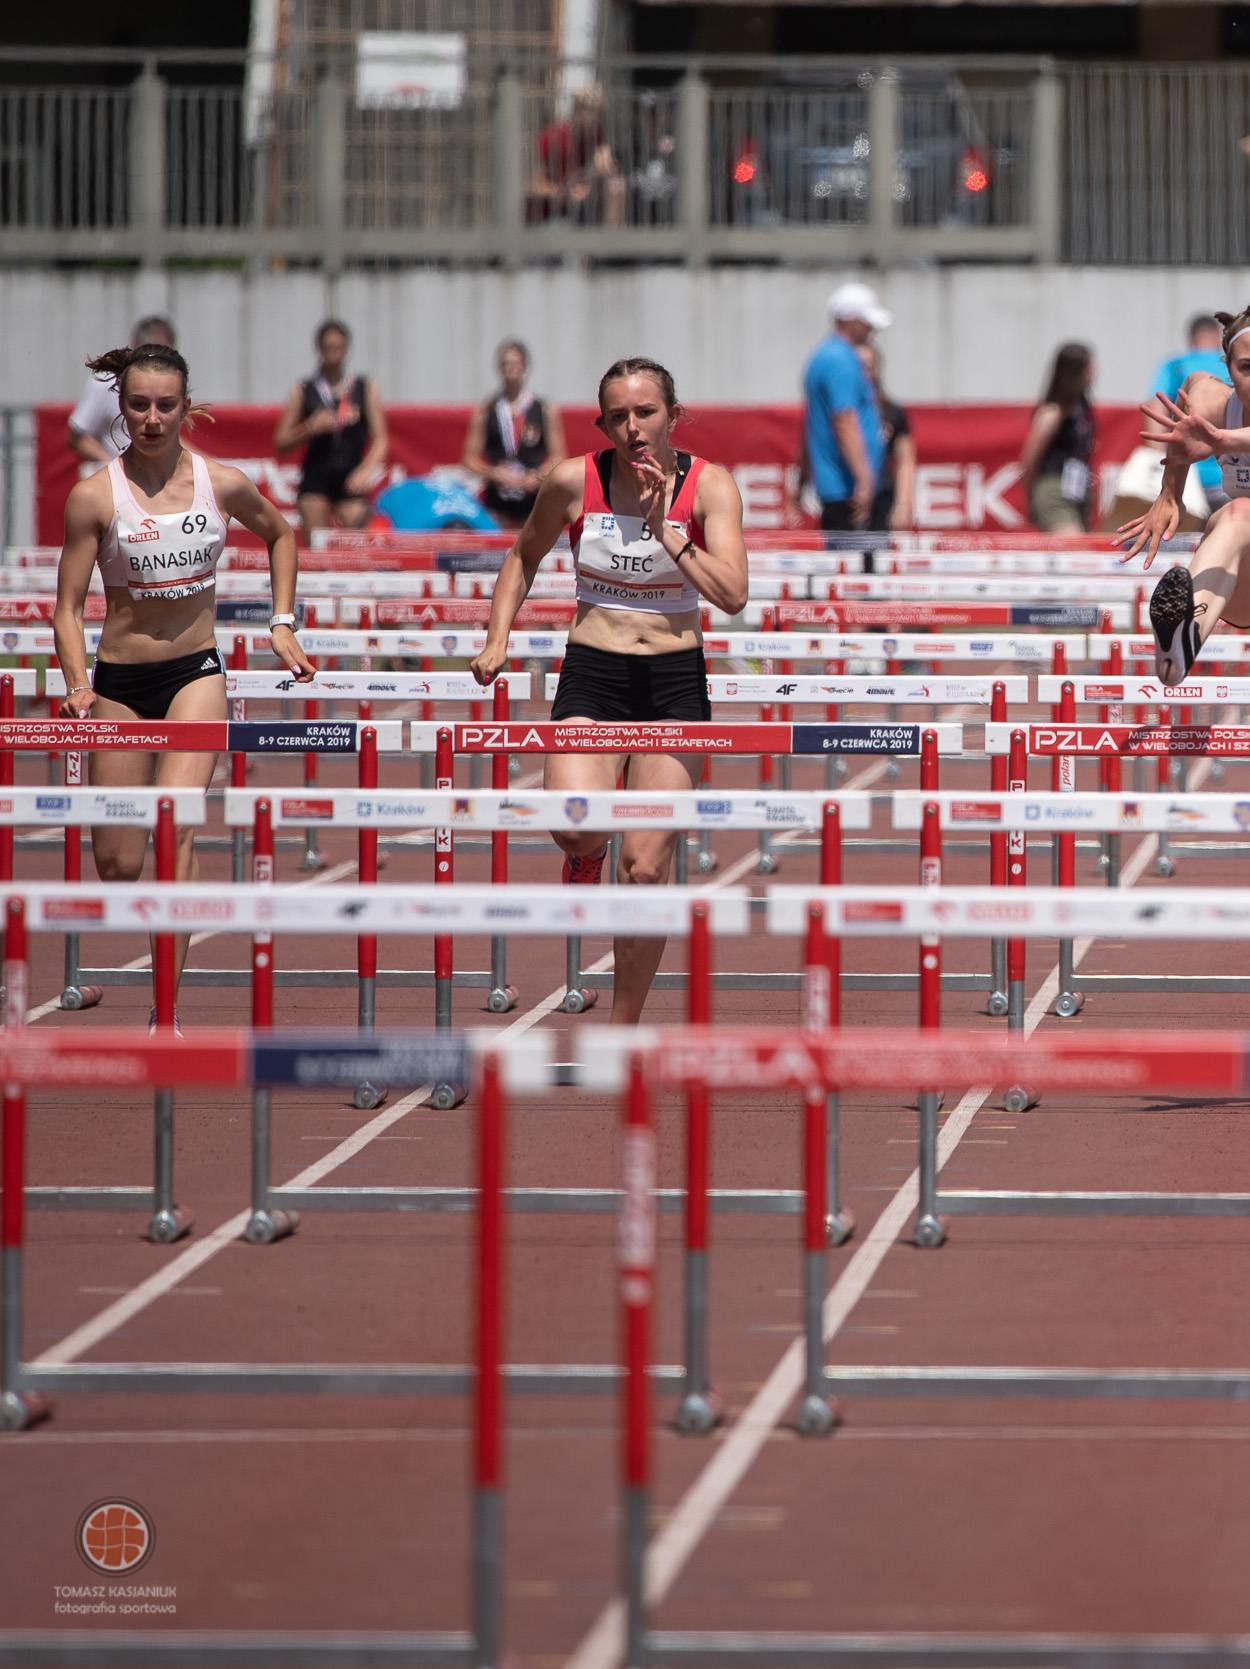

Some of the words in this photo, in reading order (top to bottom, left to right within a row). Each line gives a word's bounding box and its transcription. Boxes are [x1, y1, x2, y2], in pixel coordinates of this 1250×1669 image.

[181, 514, 207, 535] 69
[129, 532, 158, 542] ORLEN
[129, 546, 213, 571] BANASIAK
[610, 554, 654, 573] STEĆ
[141, 588, 184, 600] KRAKÓW
[187, 584, 205, 596] 2019
[593, 582, 639, 599] KRAKÓW
[641, 590, 665, 600] 2019
[0, 604, 42, 618] ZLA
[275, 680, 296, 691] 4F
[776, 684, 798, 695] 4F
[1164, 687, 1201, 697] ORLEN
[0, 724, 74, 733] ISTRZOSTWA
[77, 724, 118, 733] POLSKI
[307, 725, 350, 736] KRAKÓW
[555, 727, 640, 736] MISTRZOSTWA
[642, 727, 682, 736] POLSKI
[870, 728, 913, 739] KRAKÓW
[4, 735, 89, 744] WIELOBOJACH
[96, 736, 168, 744] SZTAFETACH
[462, 728, 545, 748] PZLA
[1035, 731, 1118, 750] PZLA
[1128, 731, 1212, 739] MISTRZOSTWA
[258, 736, 274, 745] 8-9
[276, 736, 325, 746] CZERWCA
[327, 737, 350, 746] 2019
[555, 738, 567, 747] W
[569, 738, 654, 747] WIELOBOJACH
[661, 738, 732, 747] SZTAFETACH
[822, 739, 838, 748] 8-9
[840, 739, 888, 749] CZERWCA
[890, 740, 913, 749] 2019
[1128, 742, 1140, 750] W
[1143, 742, 1226, 750] WIELOBOJACH
